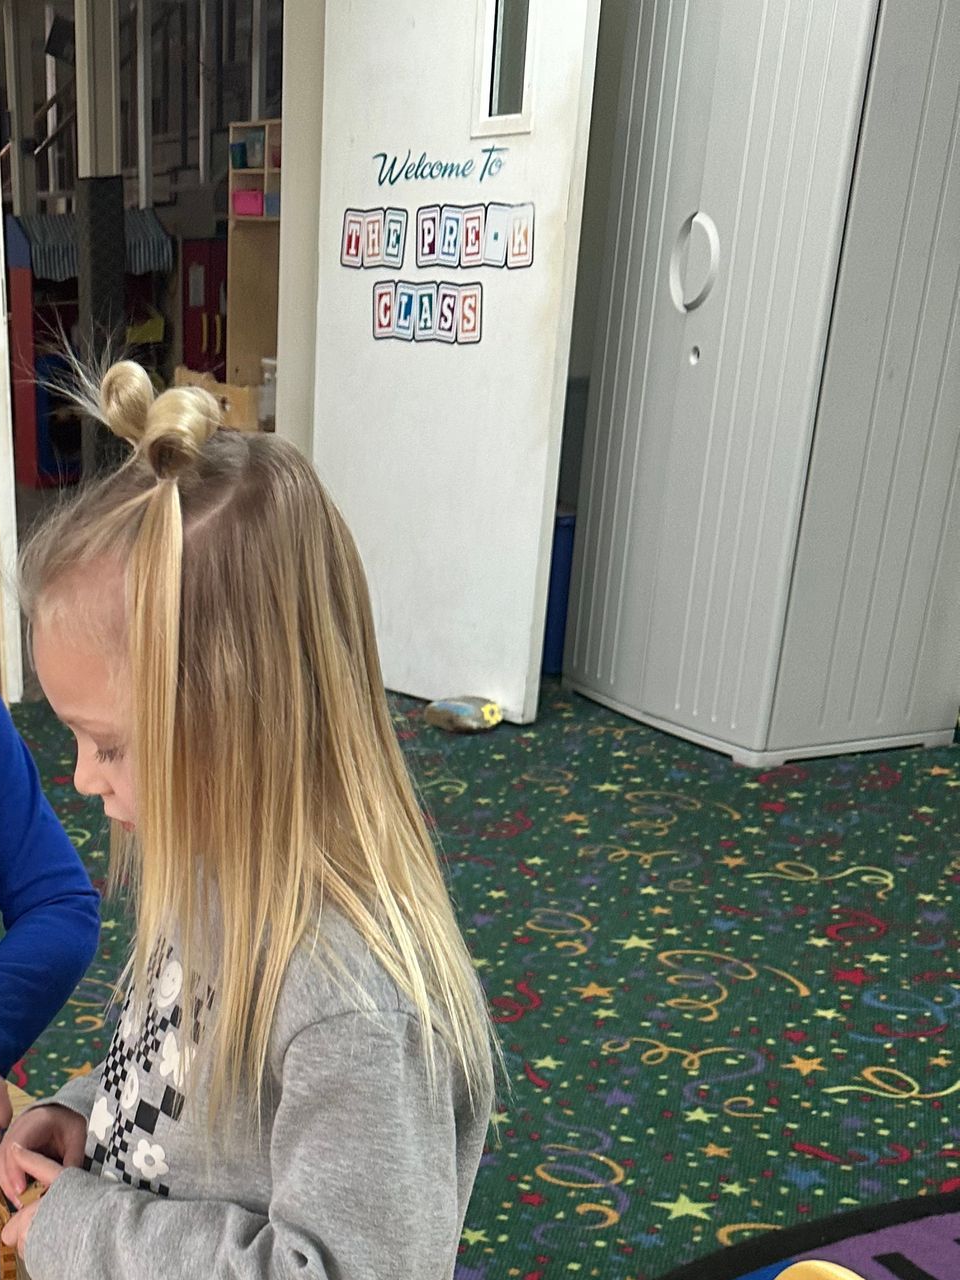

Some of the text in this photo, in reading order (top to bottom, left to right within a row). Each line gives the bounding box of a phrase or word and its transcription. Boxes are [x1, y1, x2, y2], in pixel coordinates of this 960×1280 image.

[372, 145, 510, 186] Welcome To
[343, 213, 405, 264] THE
[375, 286, 479, 339] CLASS
